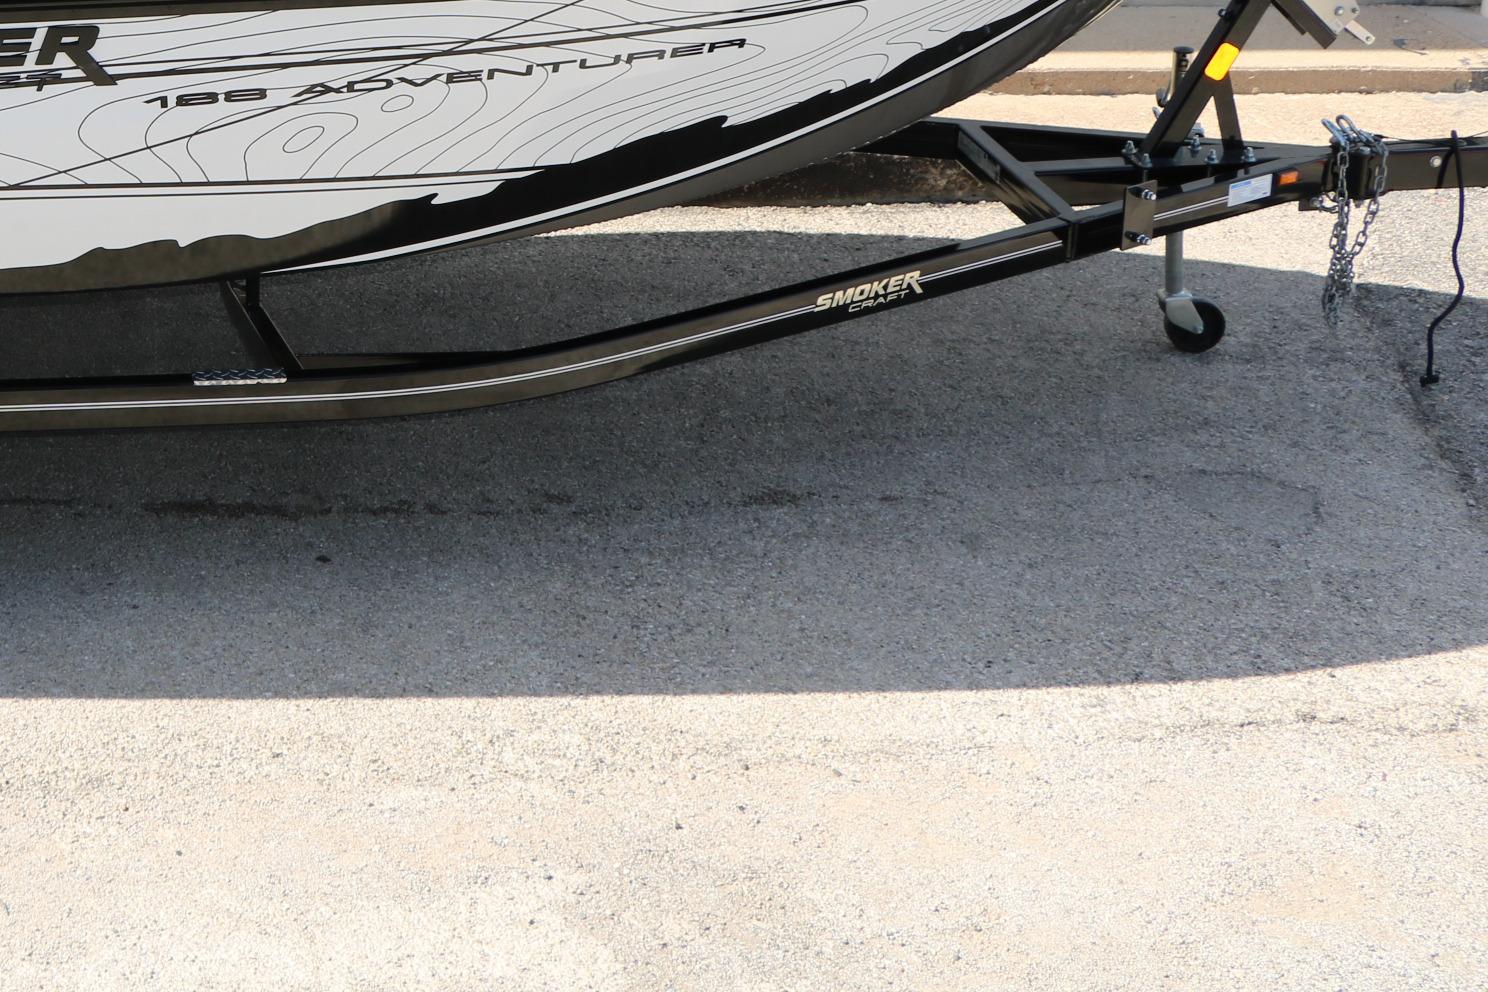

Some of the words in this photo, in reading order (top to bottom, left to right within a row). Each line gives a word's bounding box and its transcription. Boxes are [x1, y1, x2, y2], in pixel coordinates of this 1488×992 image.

[144, 88, 267, 108] 188
[294, 38, 748, 97] ADVENTURER
[814, 270, 923, 312] SMOKER
[848, 290, 909, 312] CRAFT
